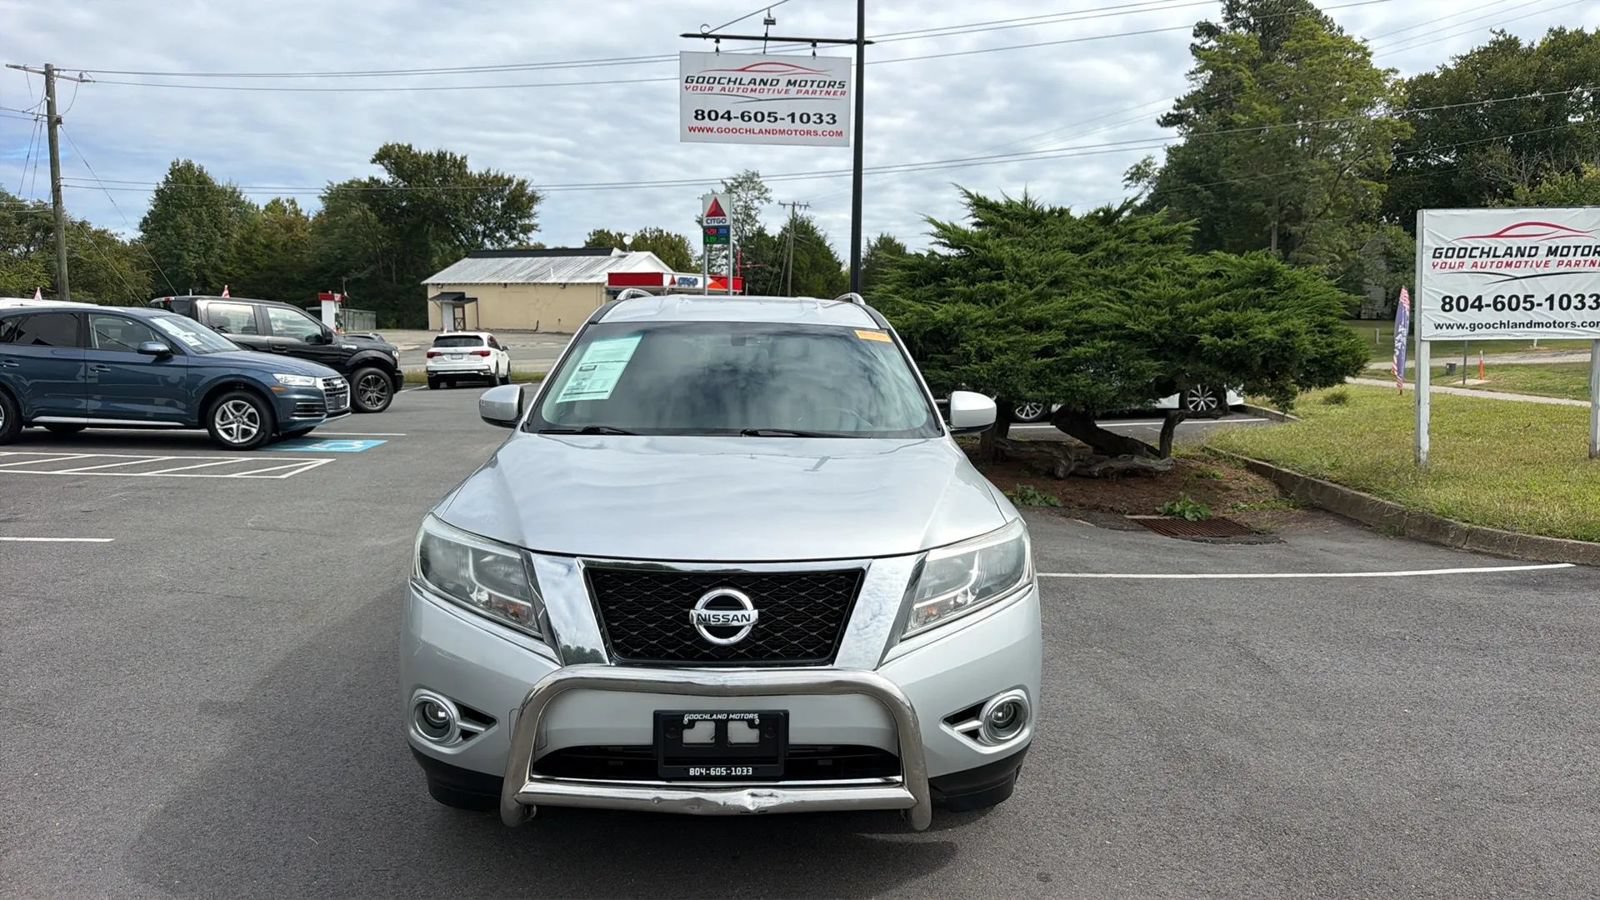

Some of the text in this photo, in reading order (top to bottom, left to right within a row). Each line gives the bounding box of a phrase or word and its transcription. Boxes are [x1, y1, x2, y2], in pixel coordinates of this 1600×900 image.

[684, 75, 847, 89] GOOCHLAND MOTORS
[720, 86, 790, 95] AUTOMOTIVE
[694, 109, 837, 125] 804-605-1033
[688, 126, 843, 137] WWW.GOOCHLANDMOTORS.COM
[1432, 246, 1540, 259] GOOCHLAND
[1431, 260, 1600, 270] YOUR AUTOMOTIVE PARTN
[1440, 293, 1600, 313] 804-605-1033
[697, 614, 751, 623] NISSAN
[689, 767, 753, 776] 804-605-1033
